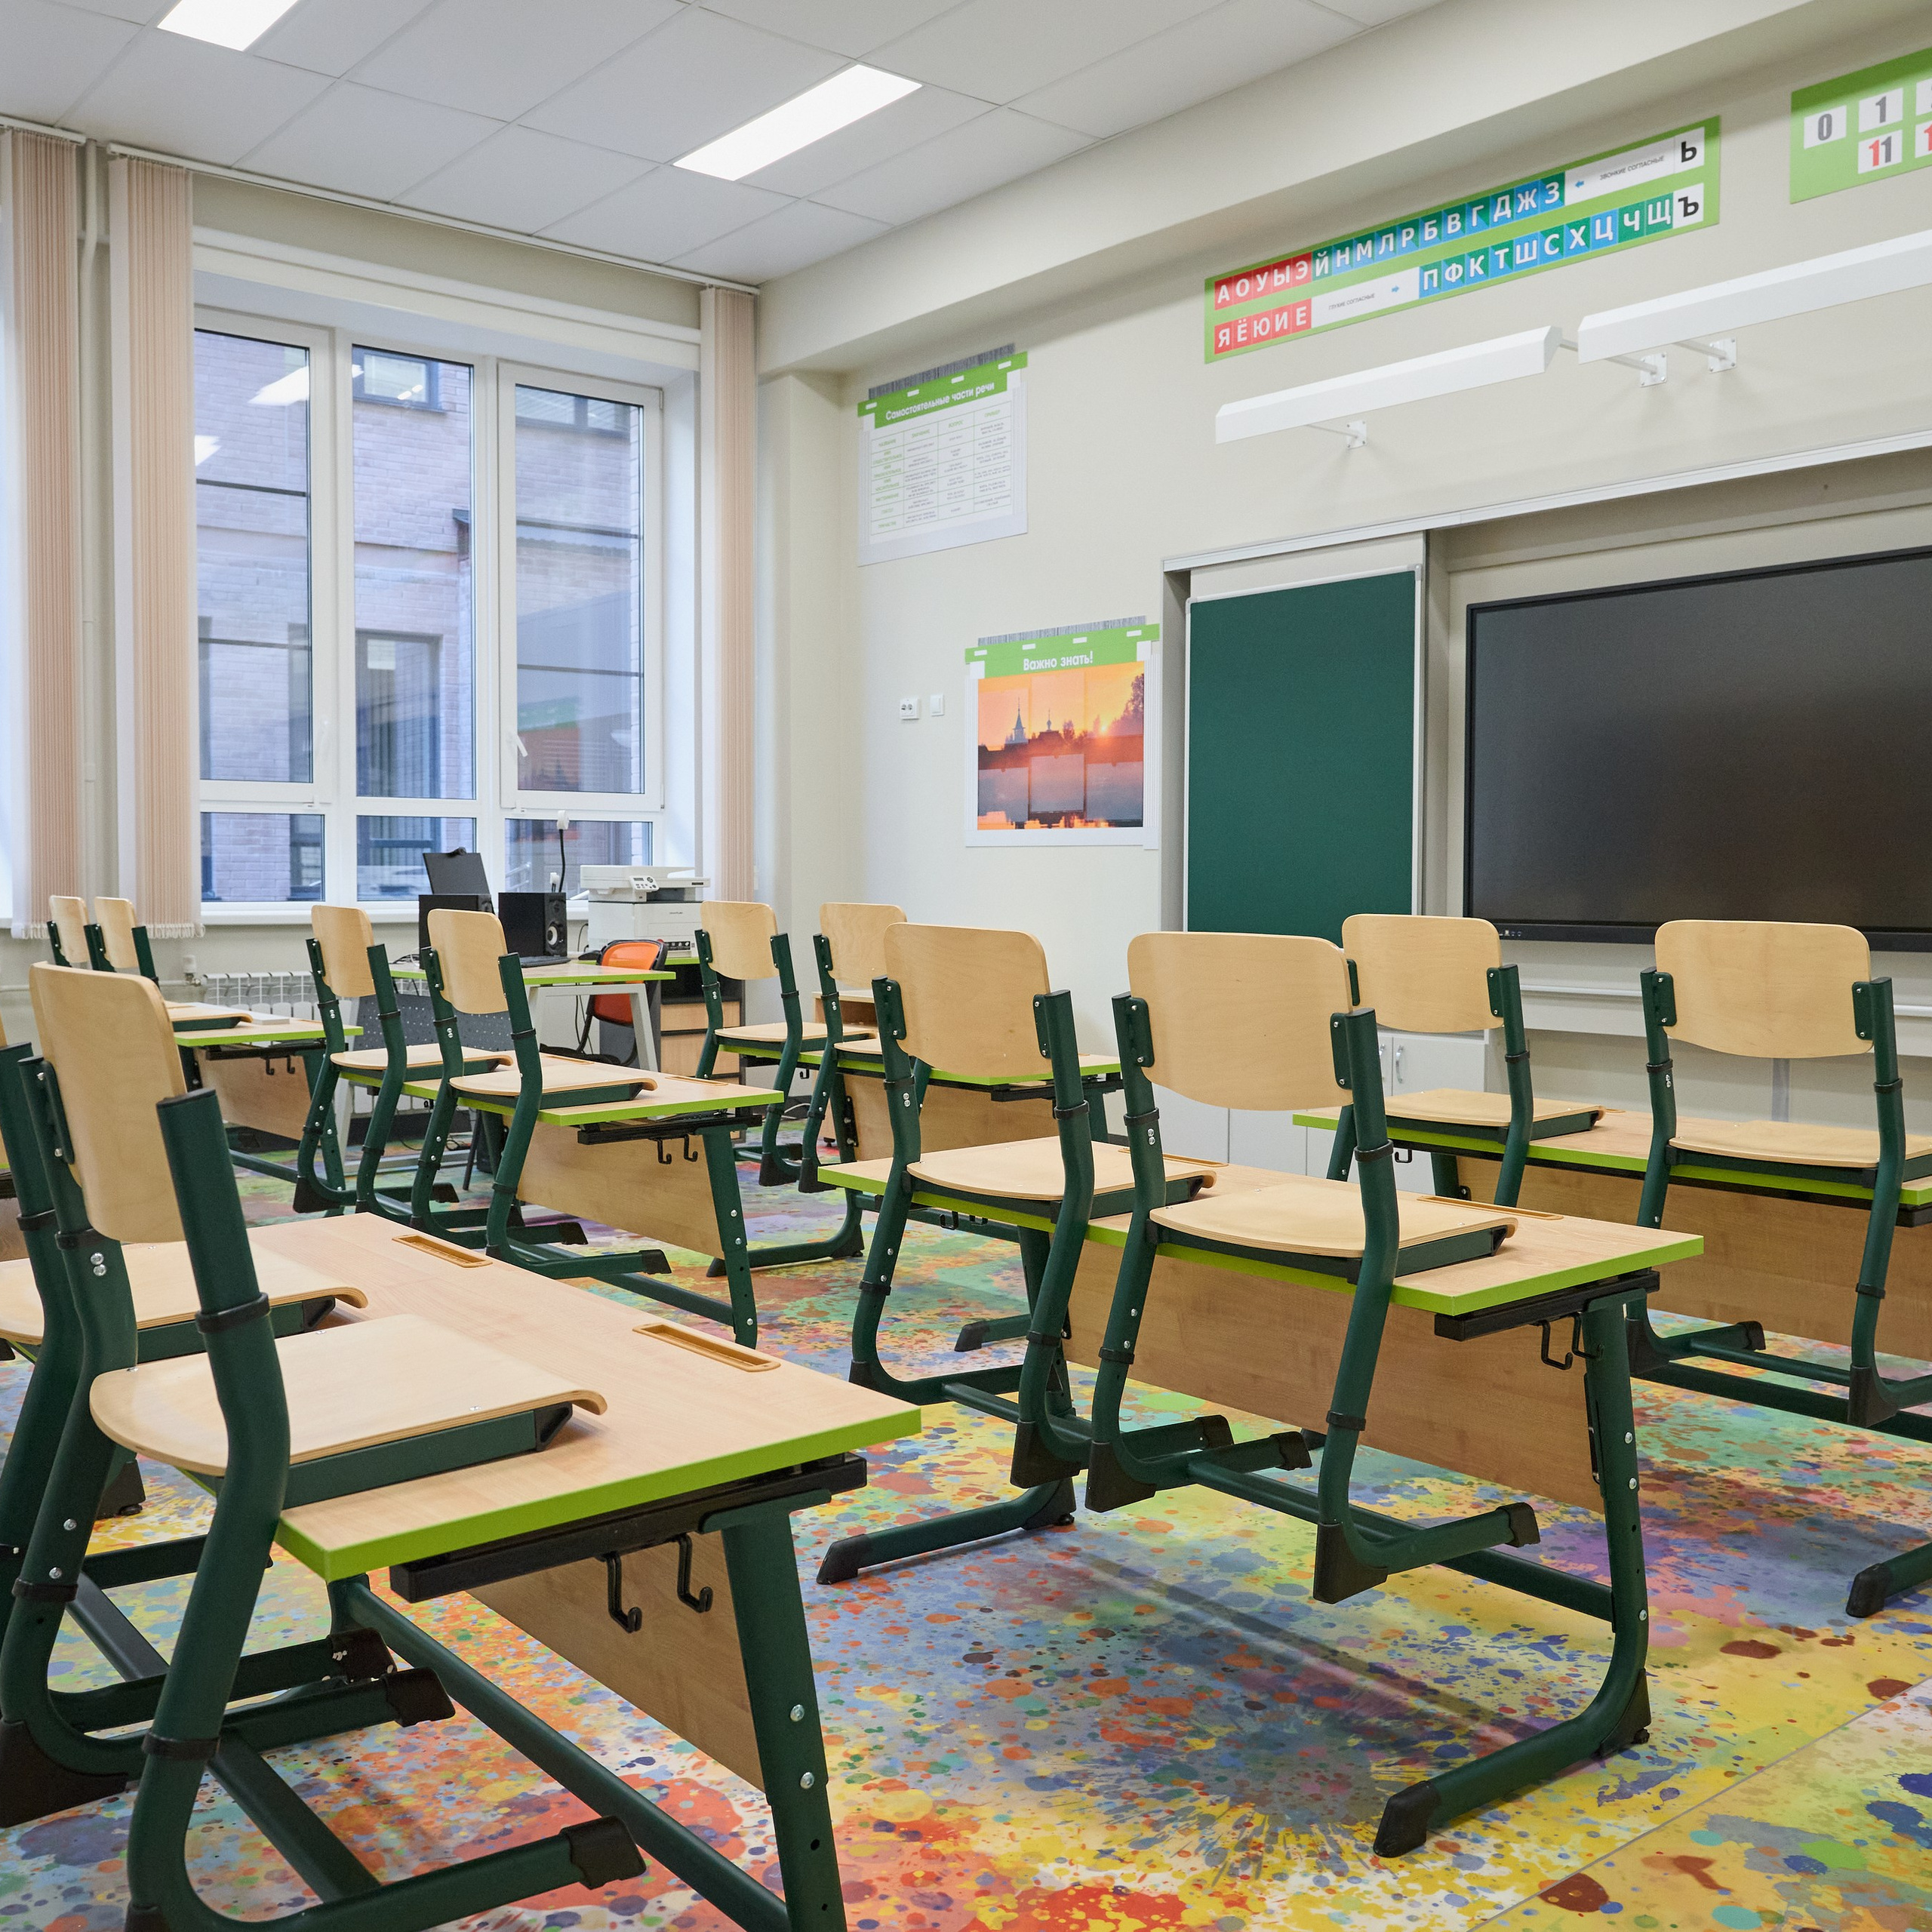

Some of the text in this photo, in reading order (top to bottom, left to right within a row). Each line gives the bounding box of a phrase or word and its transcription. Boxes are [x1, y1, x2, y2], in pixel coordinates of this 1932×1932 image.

[1817, 96, 1887, 141] 0 1
[1681, 140, 1697, 162] Ь
[1869, 123, 1932, 167] 11 1
[1627, 155, 1664, 172] СОГЛАСНЫЕ
[1678, 196, 1700, 217] Ъ
[885, 382, 995, 420] Самостоятельные части речи
[1023, 651, 1094, 671] Важно знать!
